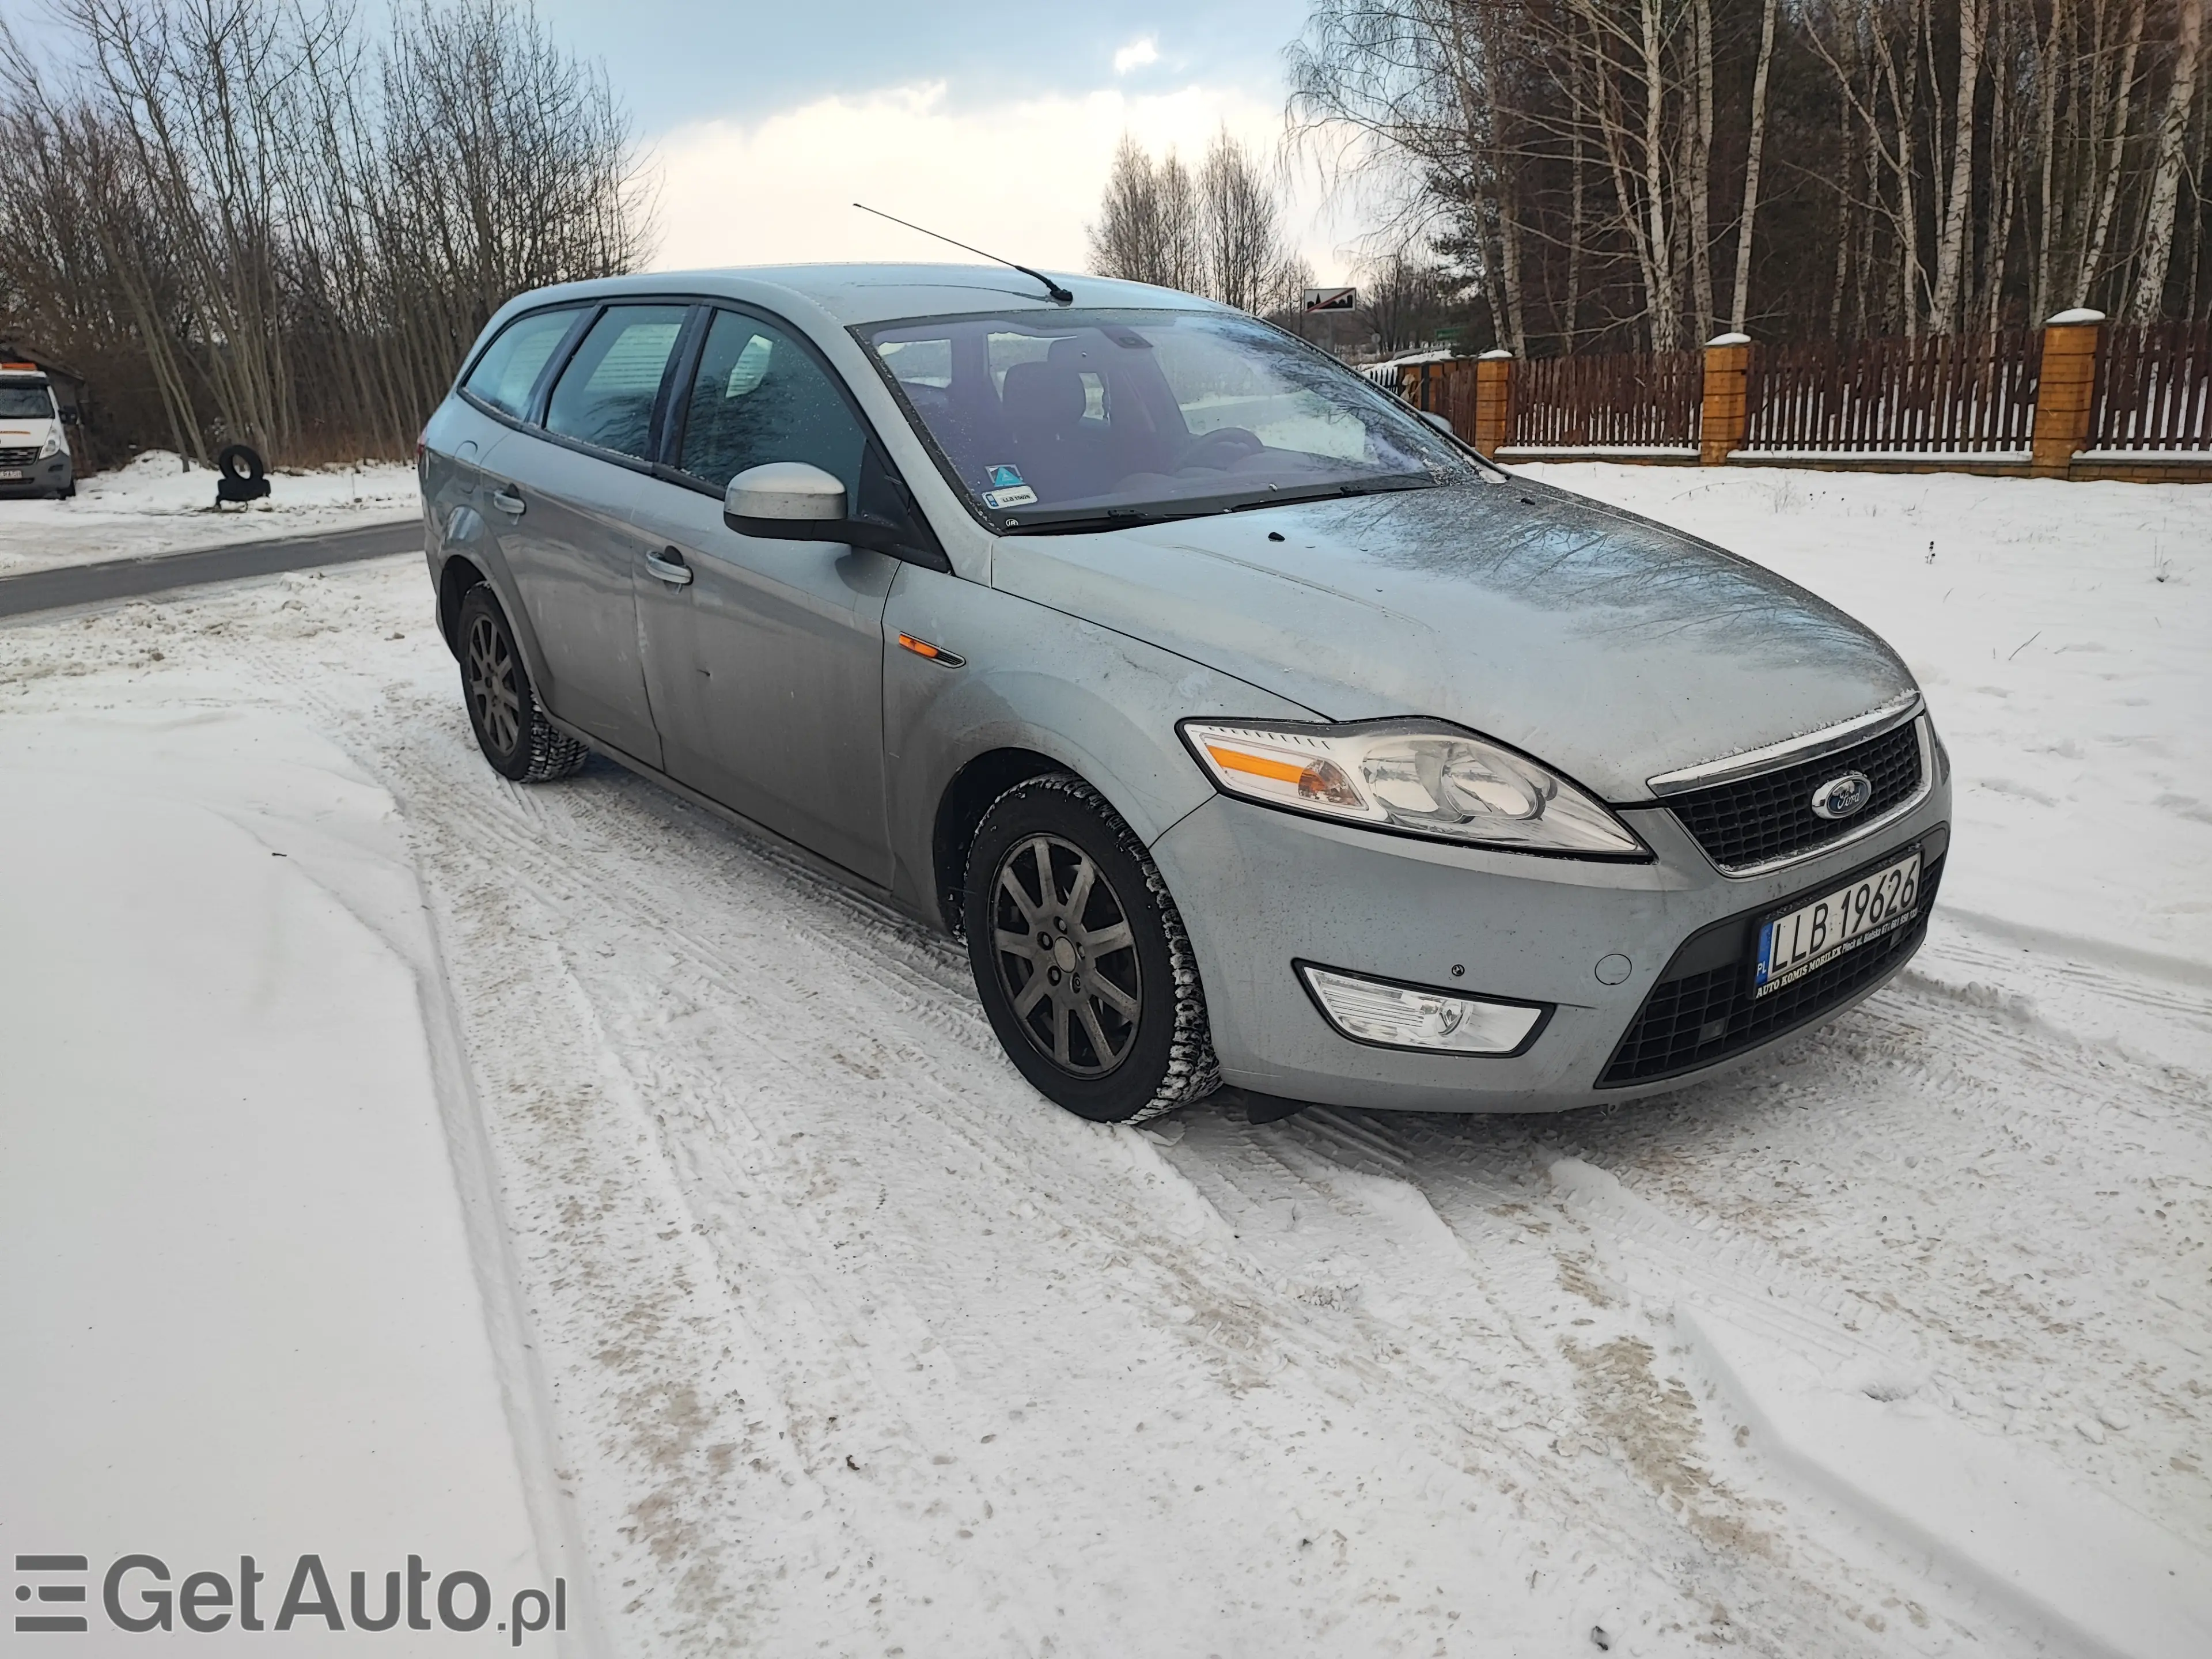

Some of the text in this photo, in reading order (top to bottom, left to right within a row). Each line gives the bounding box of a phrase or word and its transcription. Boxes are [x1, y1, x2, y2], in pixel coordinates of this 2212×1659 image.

[1837, 787, 1861, 809] Ford
[1772, 860, 1918, 973] LLB 19626
[1756, 960, 1767, 977] PL
[1756, 979, 1781, 999] AUTO
[1781, 964, 1808, 987] KOMIS
[1809, 945, 1842, 972] MOBILEX
